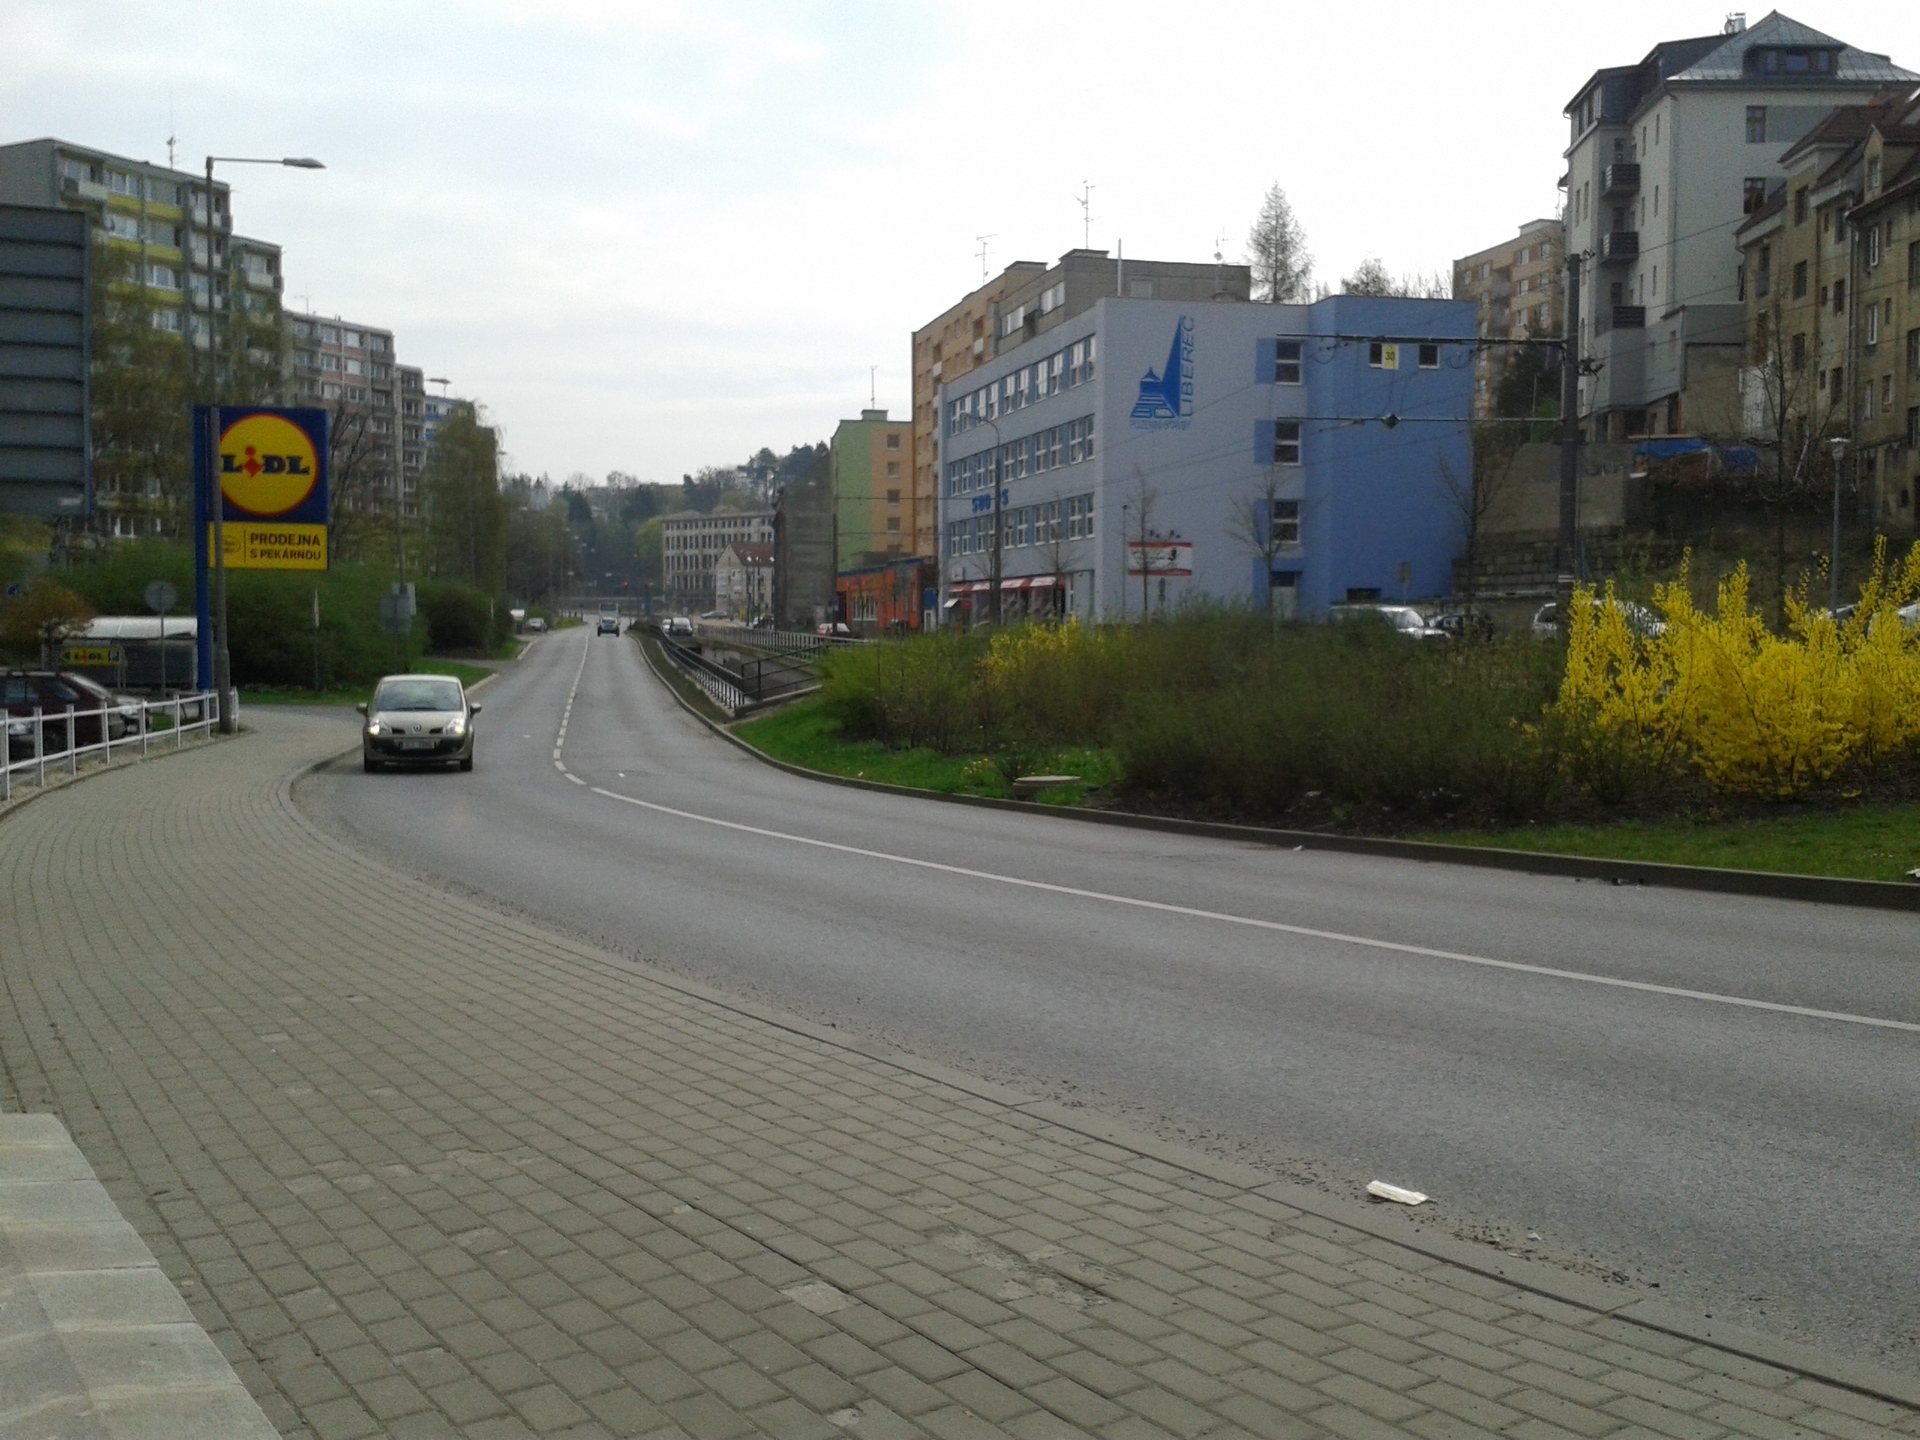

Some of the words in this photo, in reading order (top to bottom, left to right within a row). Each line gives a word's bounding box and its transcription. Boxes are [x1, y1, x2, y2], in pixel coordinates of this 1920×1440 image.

[1180, 315, 1195, 417] LIBEREC
[250, 533, 321, 547] PRODEJNA
[250, 549, 258, 559] S
[260, 548, 321, 560] PEKÁRNOU
